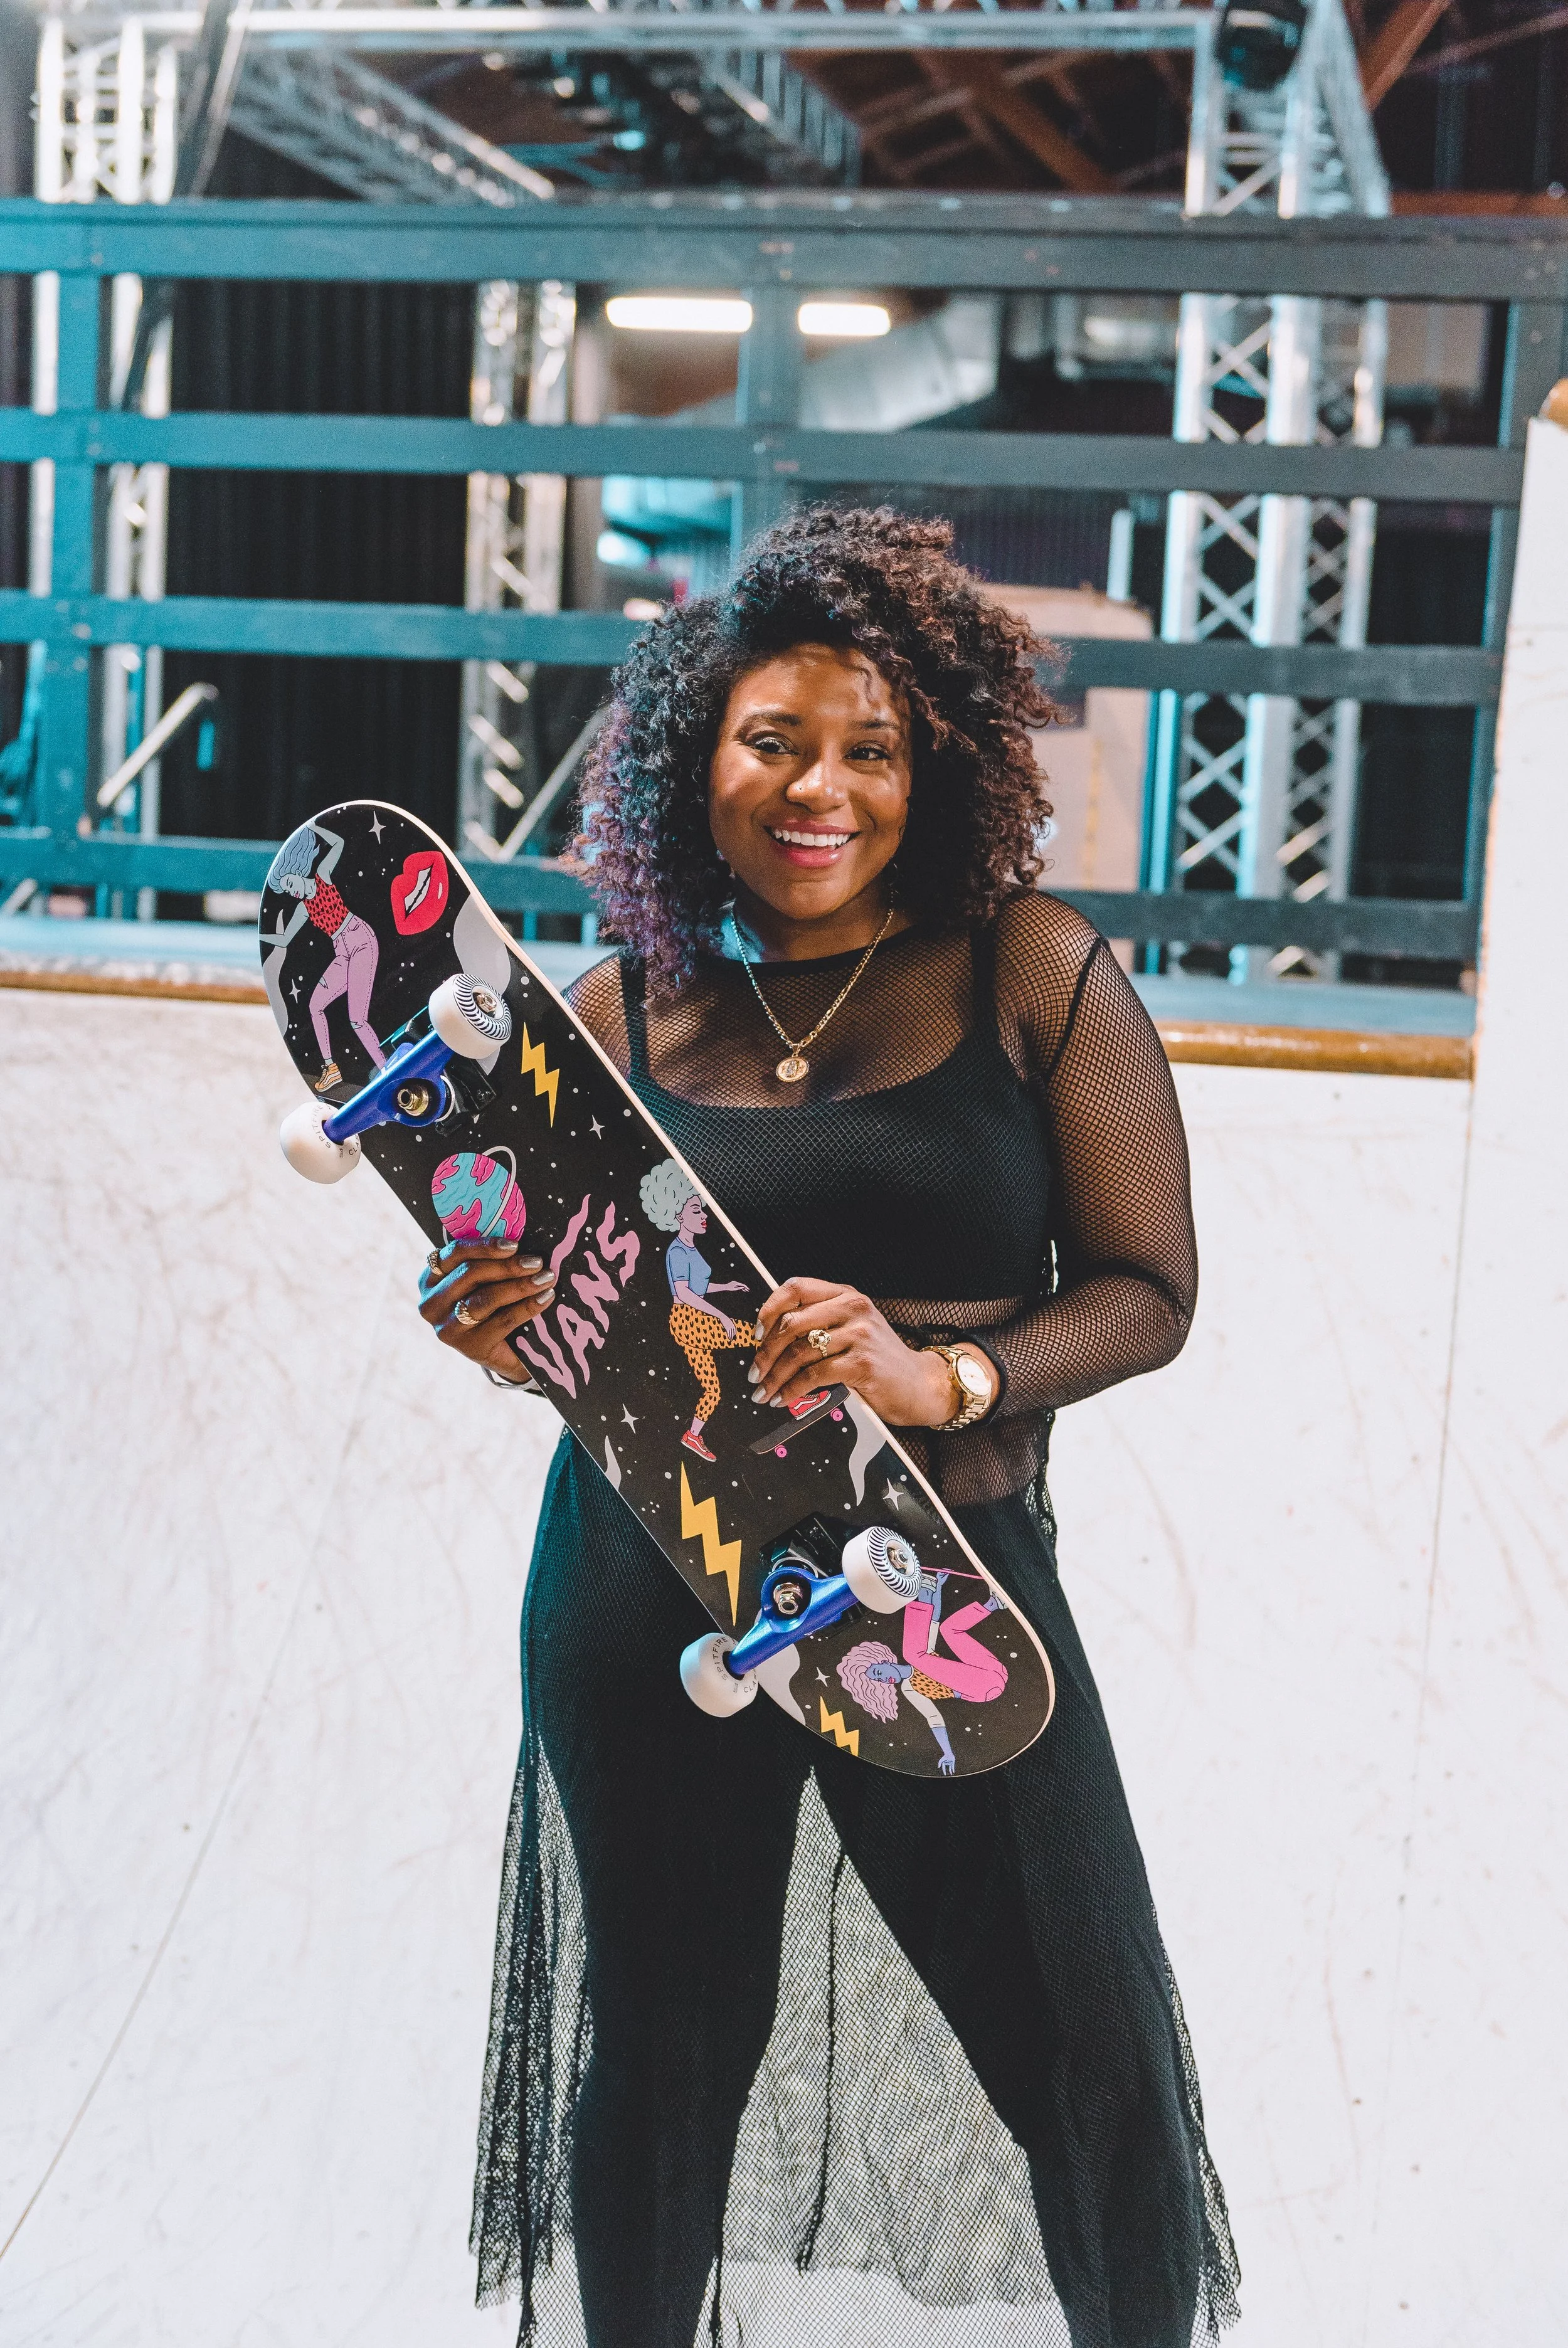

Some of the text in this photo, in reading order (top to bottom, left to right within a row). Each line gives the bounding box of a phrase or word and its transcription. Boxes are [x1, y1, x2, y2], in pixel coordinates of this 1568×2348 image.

[312, 1104, 332, 1148] SPITFIRE
[516, 1193, 640, 1399] VANS
[712, 1637, 728, 1681] SPITFIRE
